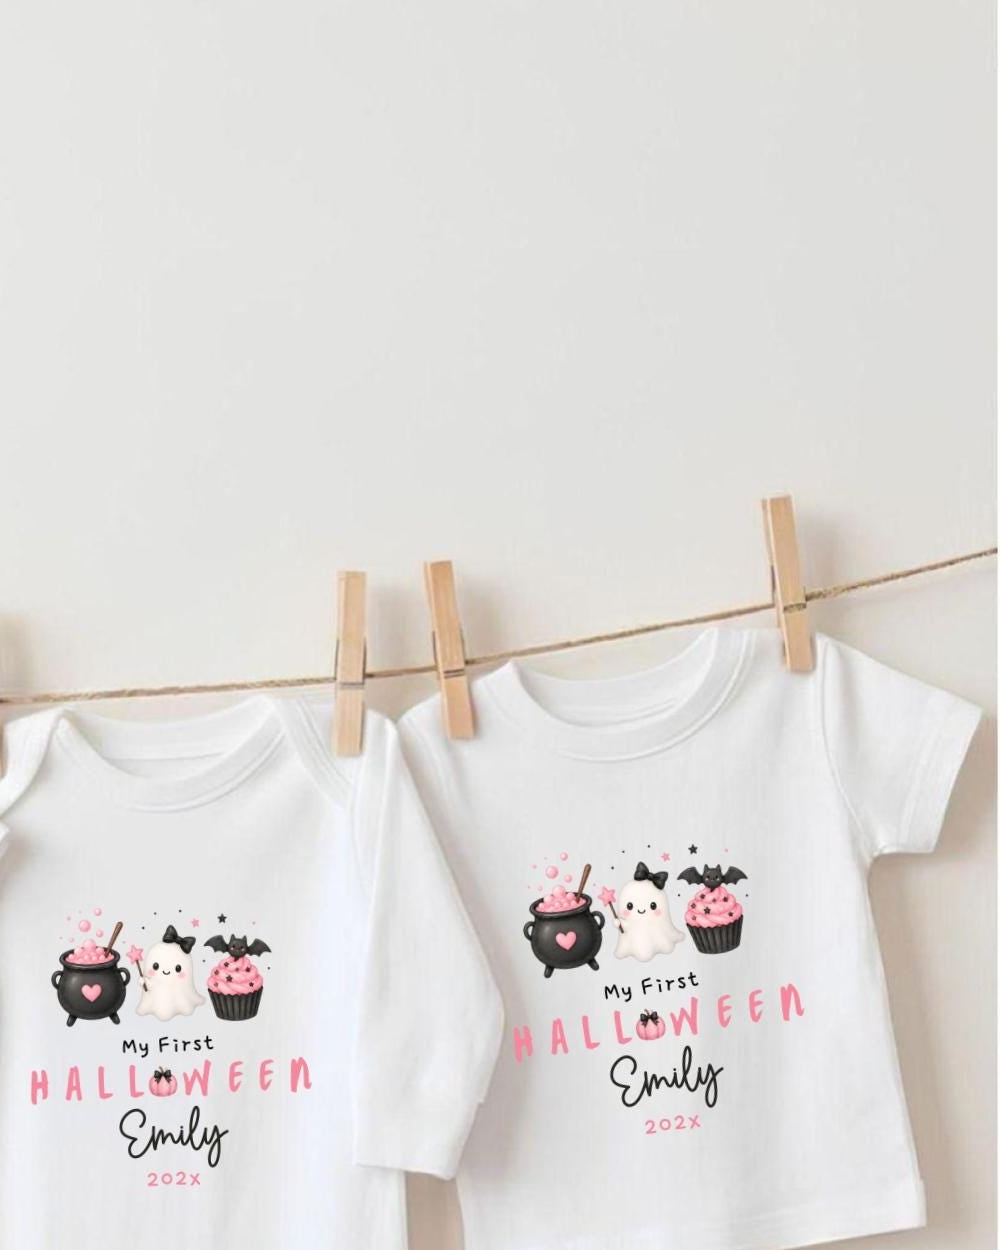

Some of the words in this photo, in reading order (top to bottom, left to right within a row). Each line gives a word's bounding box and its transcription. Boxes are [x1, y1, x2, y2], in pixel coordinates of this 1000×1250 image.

[604, 983, 633, 1003] My
[641, 971, 700, 995] First
[122, 1039, 149, 1059] My
[158, 1035, 215, 1053] First
[609, 1045, 725, 1109] Emily
[118, 1105, 230, 1169] Emily
